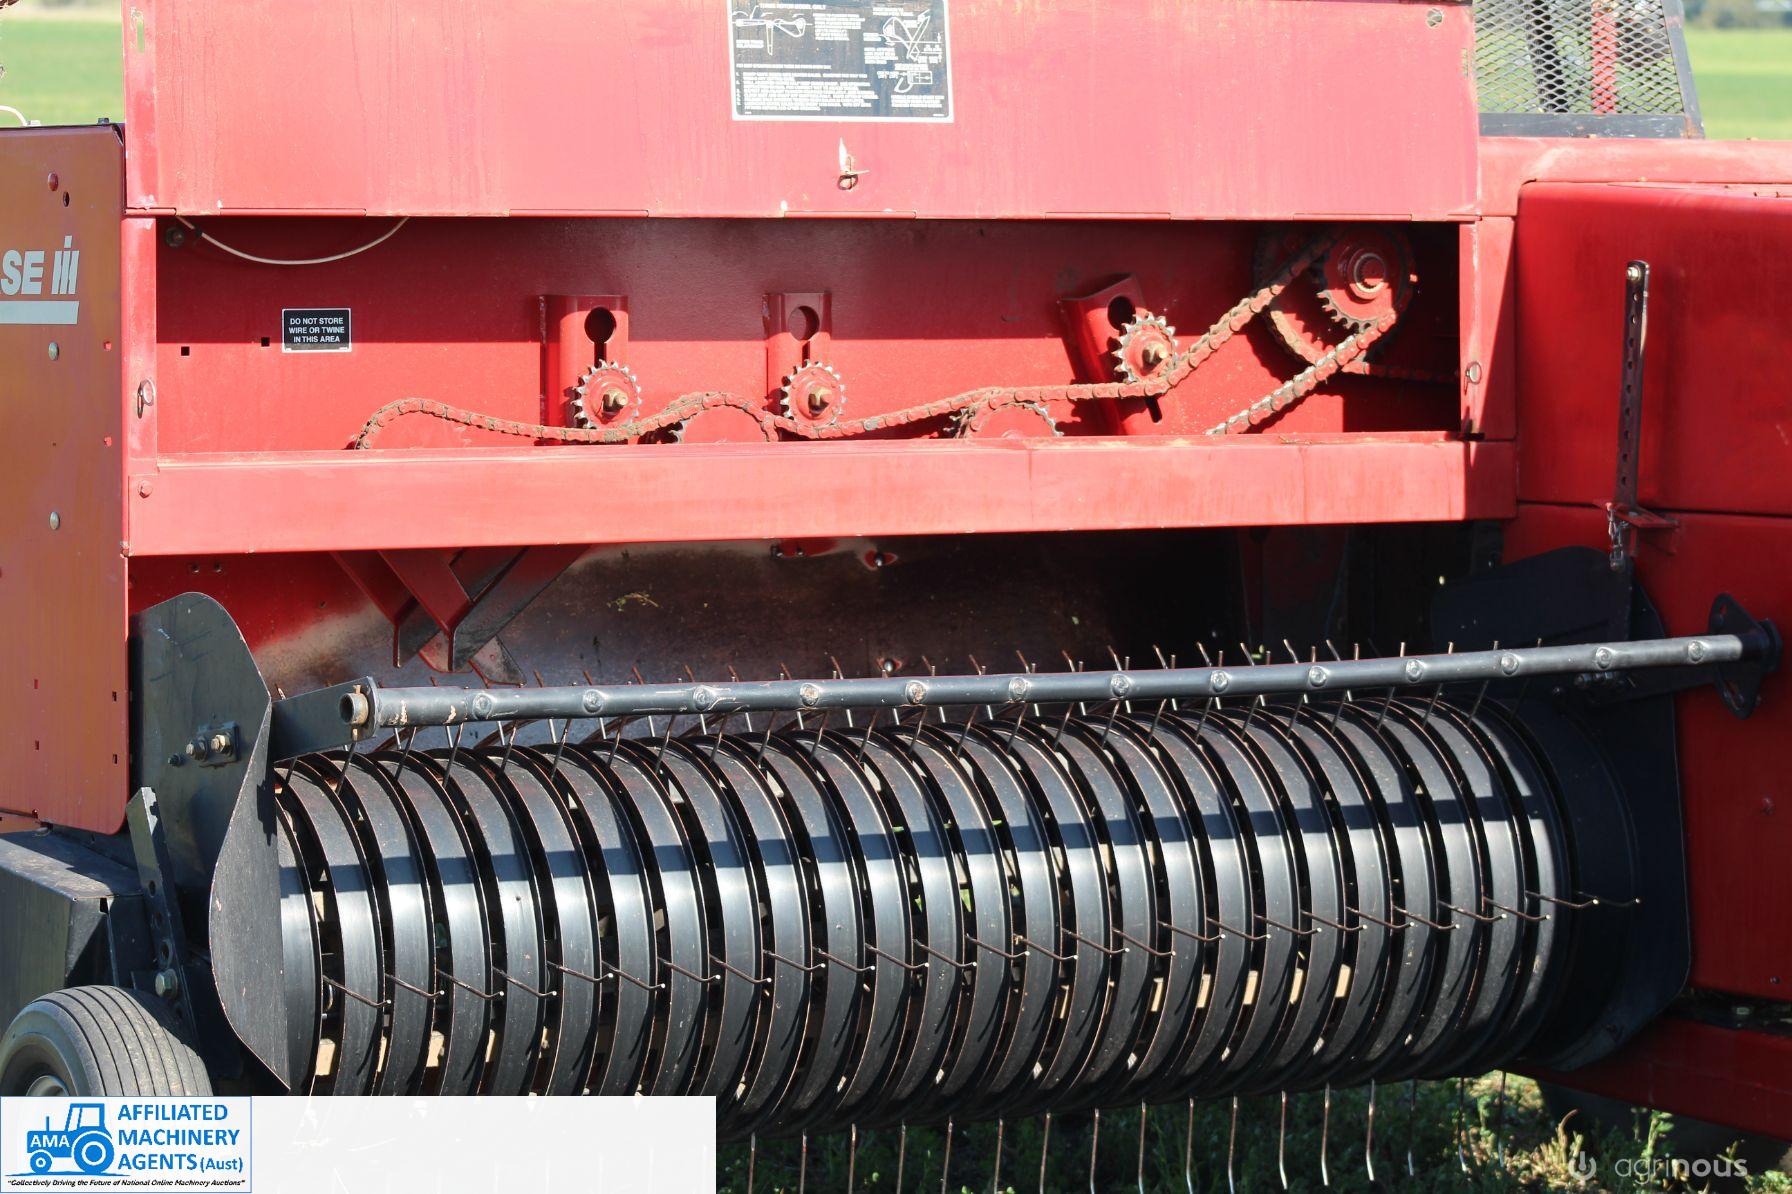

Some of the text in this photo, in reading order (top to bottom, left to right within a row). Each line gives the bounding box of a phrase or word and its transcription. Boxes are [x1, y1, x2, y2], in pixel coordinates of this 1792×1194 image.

[0, 250, 45, 296] SE
[289, 317, 343, 325] DO NOT STORE
[321, 326, 345, 334] TWINE
[302, 335, 319, 343] THIS
[320, 335, 340, 343] AREA
